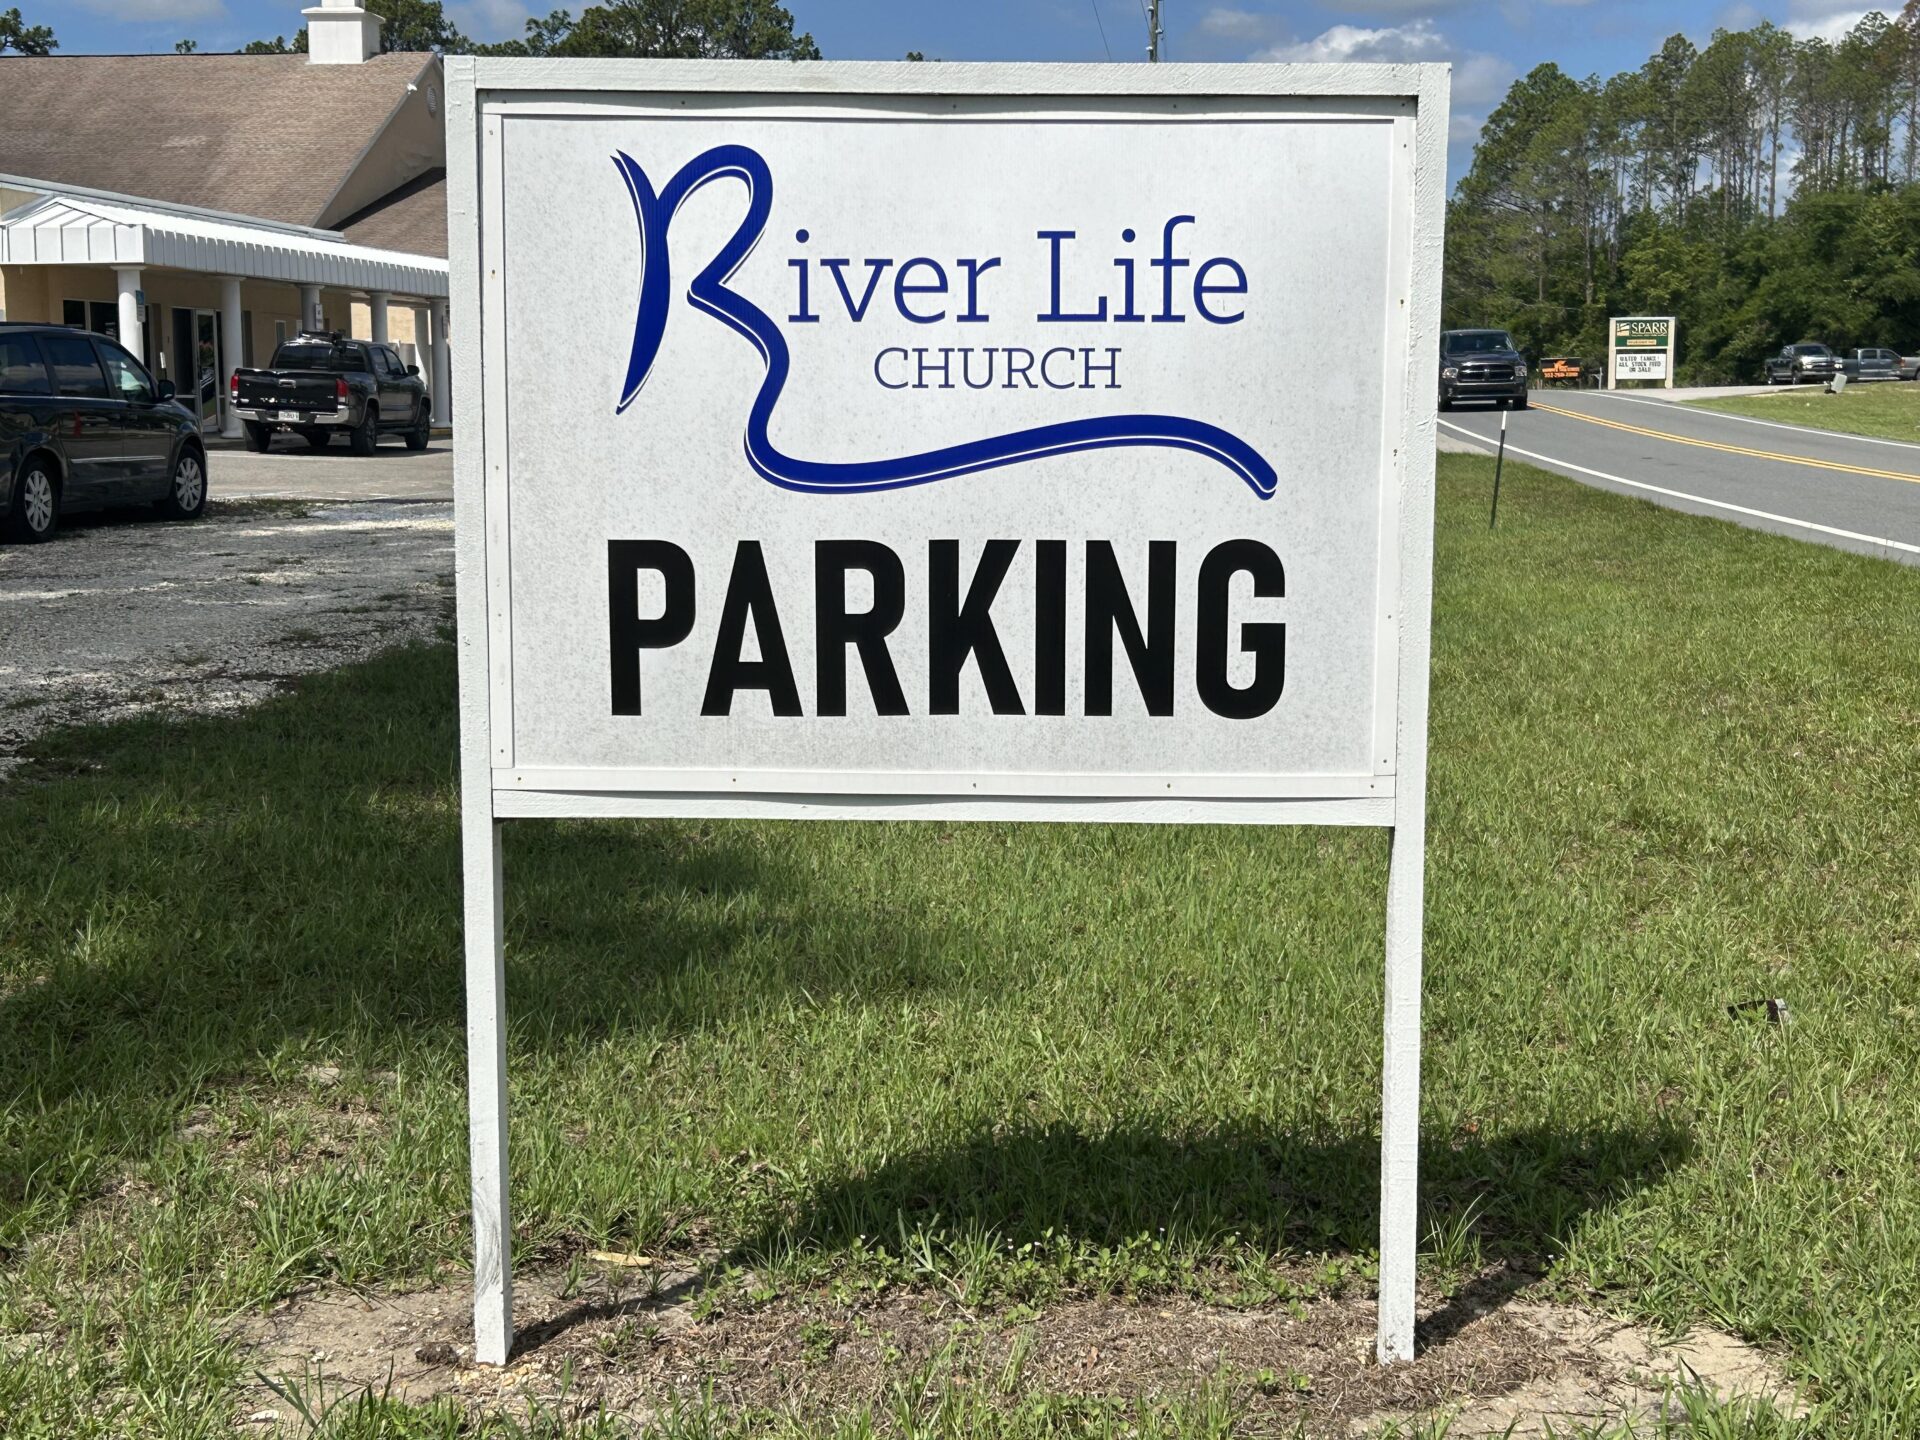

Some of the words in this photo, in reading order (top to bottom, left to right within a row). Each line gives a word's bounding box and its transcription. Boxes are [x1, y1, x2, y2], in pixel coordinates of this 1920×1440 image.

[610, 144, 1001, 415] River
[1037, 215, 1249, 325] Life
[1631, 321, 1668, 335] SPARR
[873, 347, 1123, 390] CHURCH
[606, 538, 1287, 720] PARKING
